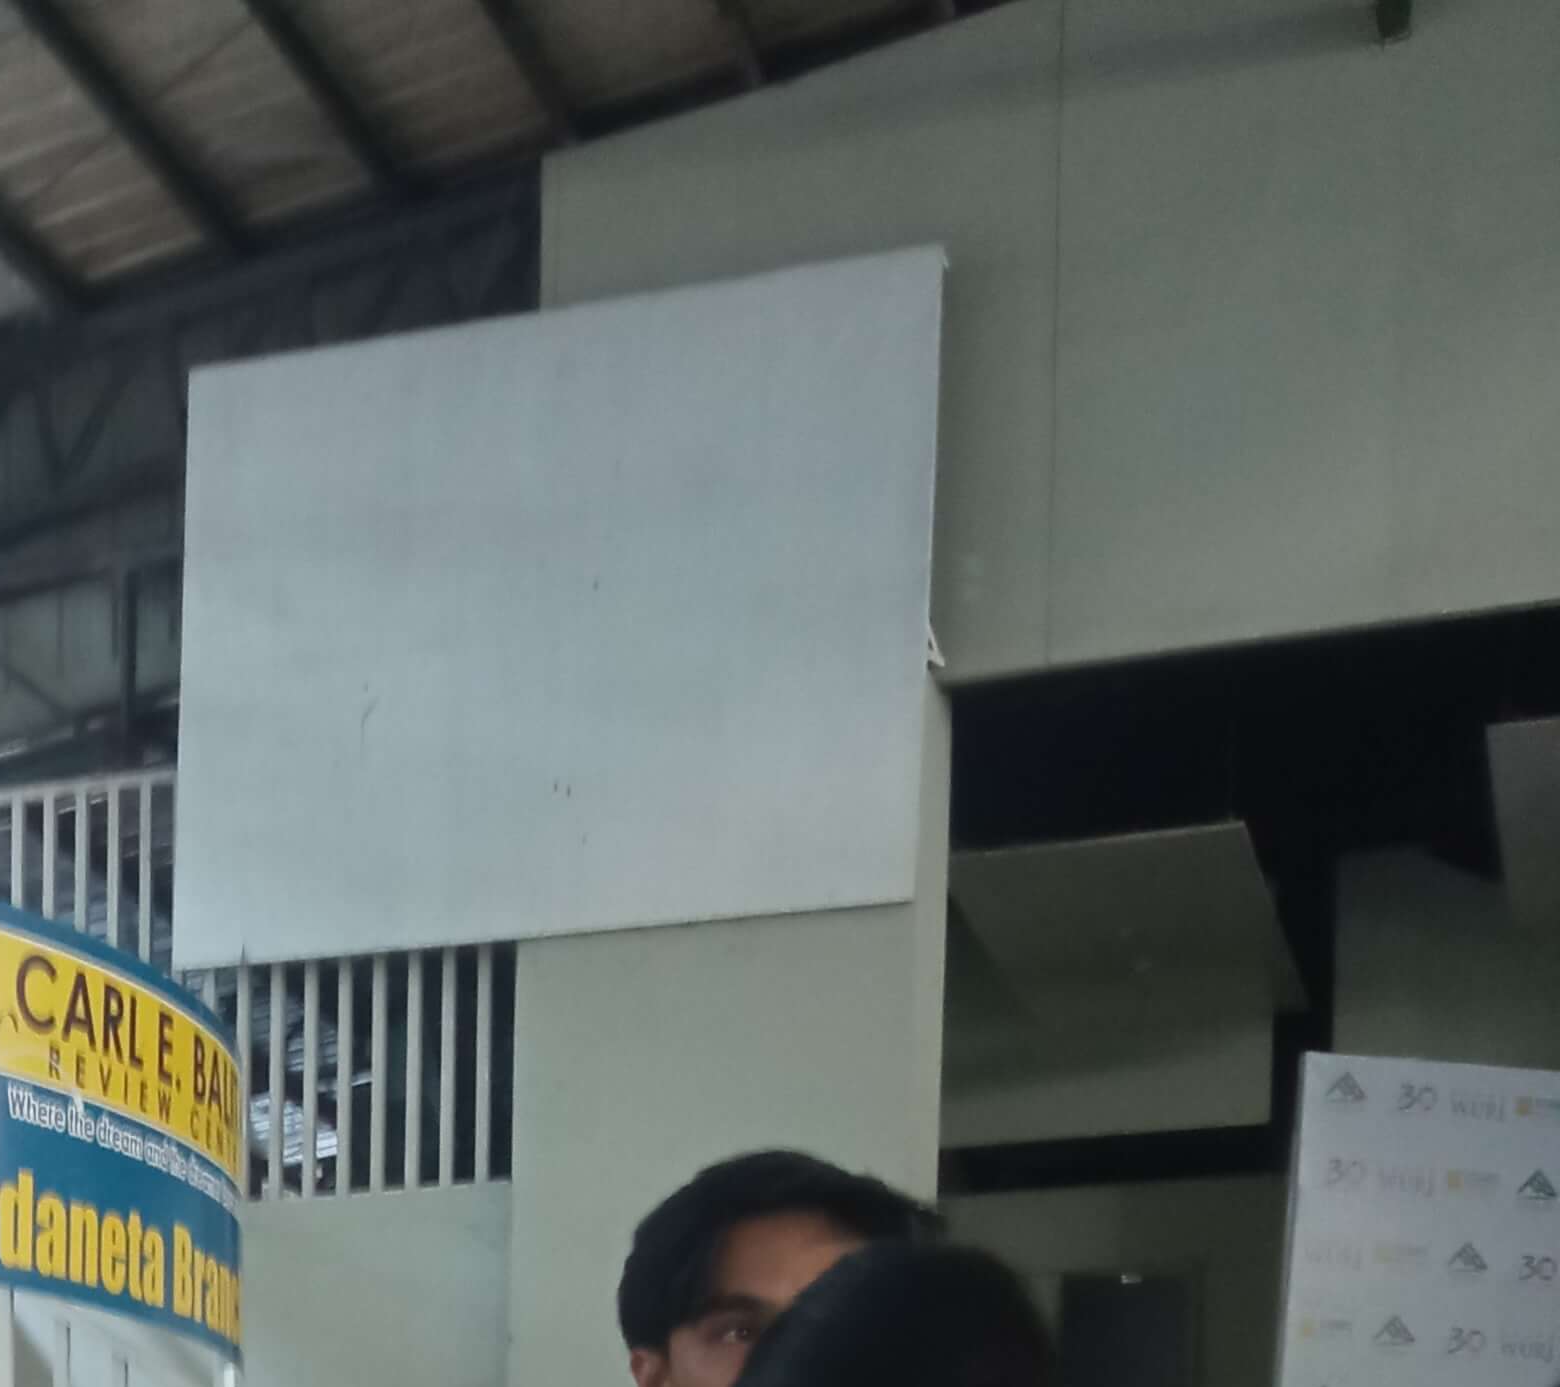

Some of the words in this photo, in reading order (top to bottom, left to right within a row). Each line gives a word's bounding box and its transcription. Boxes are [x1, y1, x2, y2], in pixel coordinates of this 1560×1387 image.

[16, 954, 144, 1073] CARL
[158, 1013, 182, 1090] E.
[48, 1045, 172, 1125] REVIEW
[1397, 1082, 1438, 1112] 30
[8, 1083, 67, 1134] Where
[68, 1093, 94, 1143] the
[96, 1112, 142, 1159] dream
[1326, 1158, 1366, 1186] 30
[1518, 1255, 1558, 1281] 30
[1447, 1327, 1486, 1355] 30
